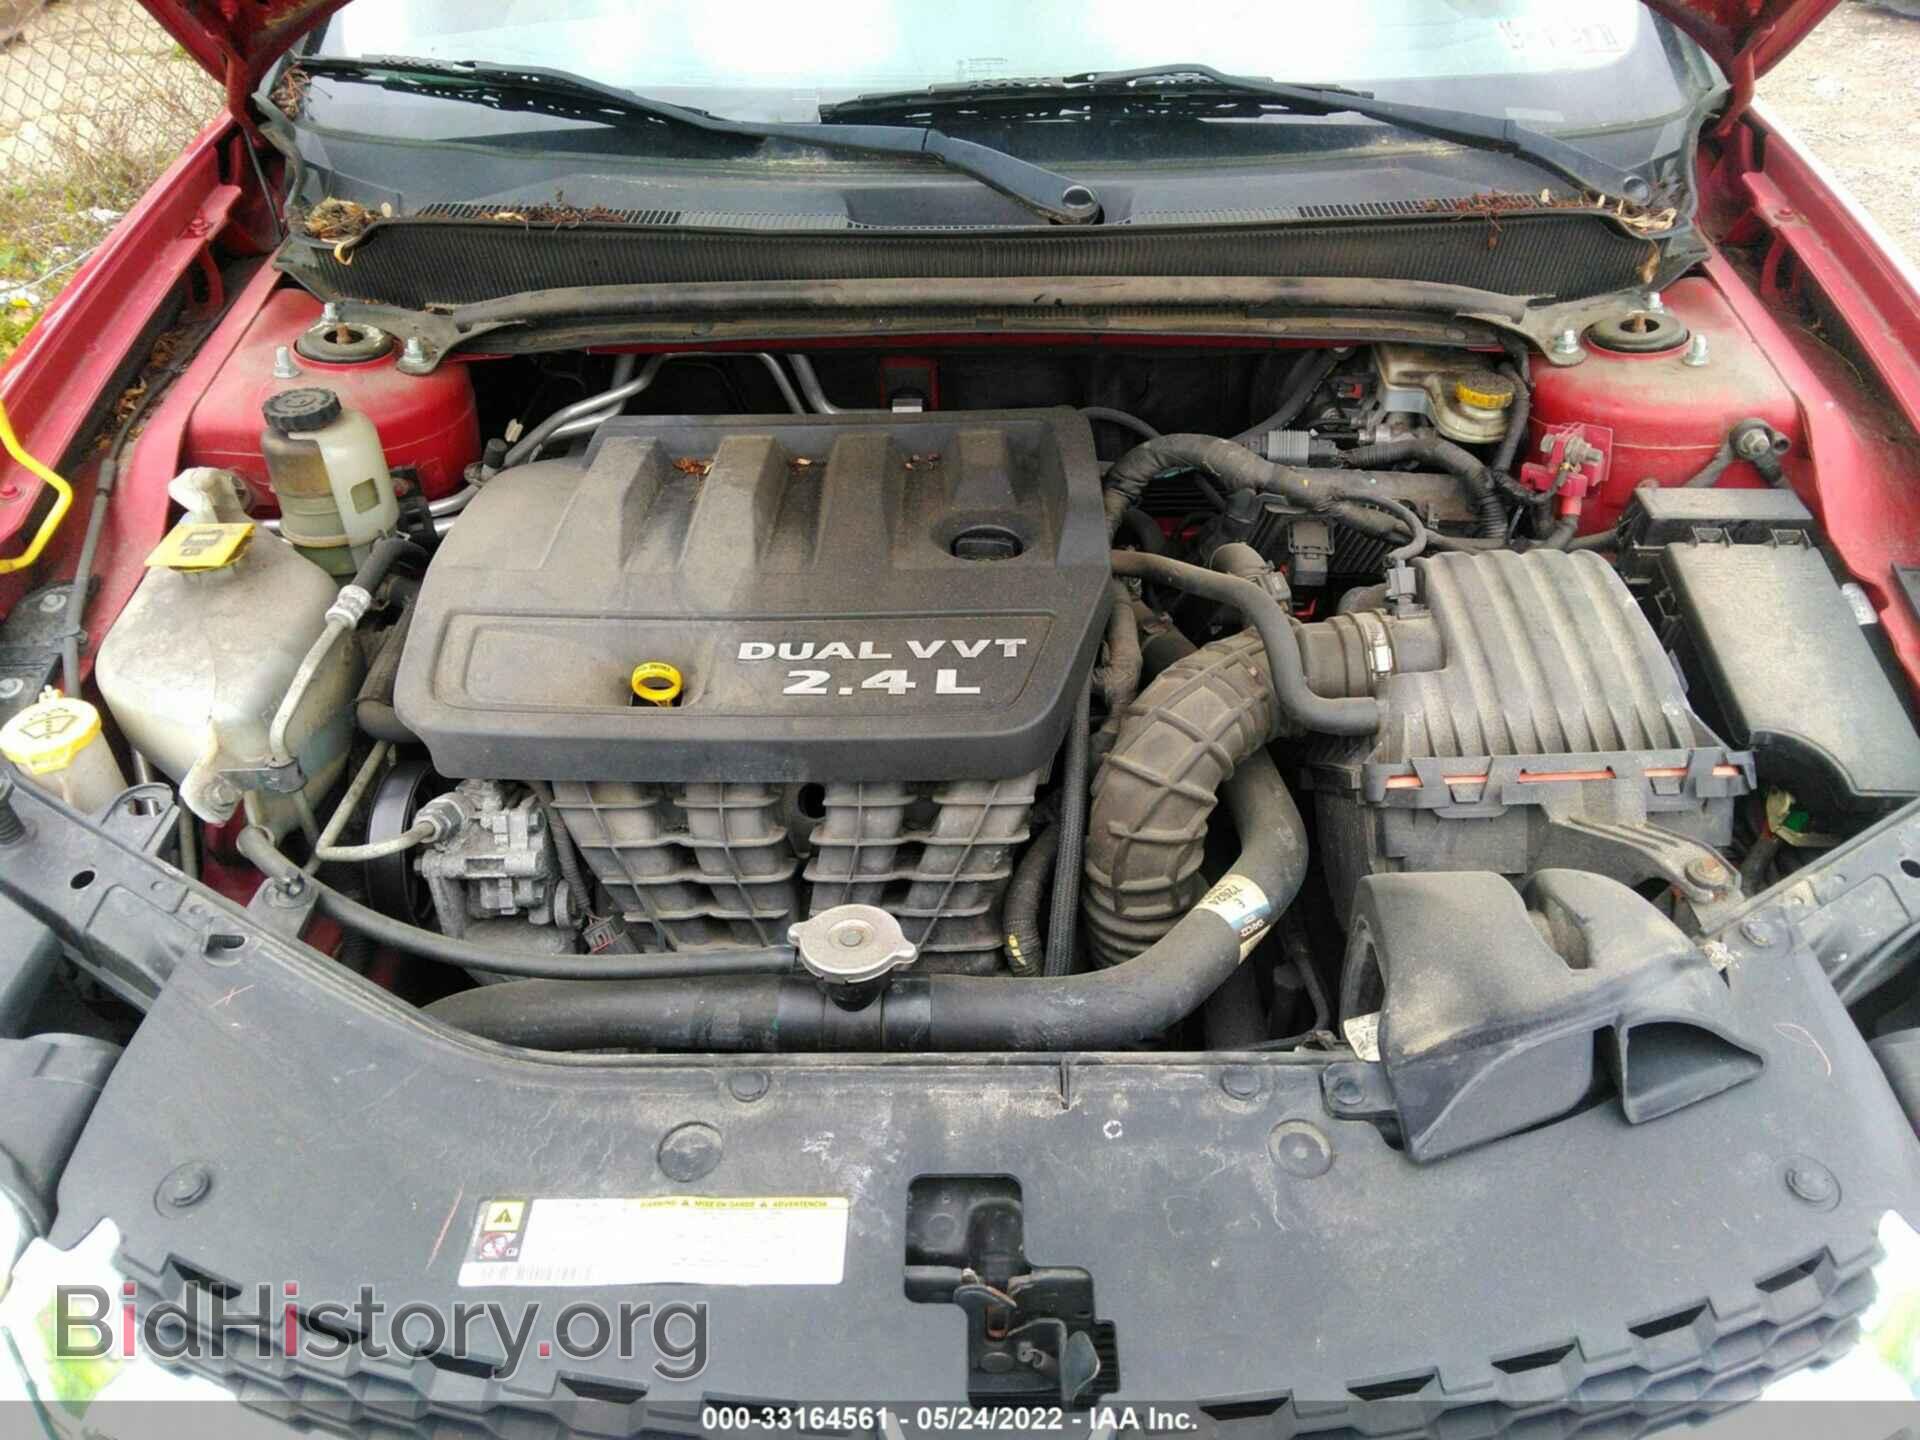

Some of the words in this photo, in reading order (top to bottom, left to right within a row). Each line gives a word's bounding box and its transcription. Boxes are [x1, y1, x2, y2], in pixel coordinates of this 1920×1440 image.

[737, 641, 892, 660] DUAL
[906, 638, 1027, 659] VVT
[782, 669, 917, 695] 2.4
[935, 669, 981, 694] L
